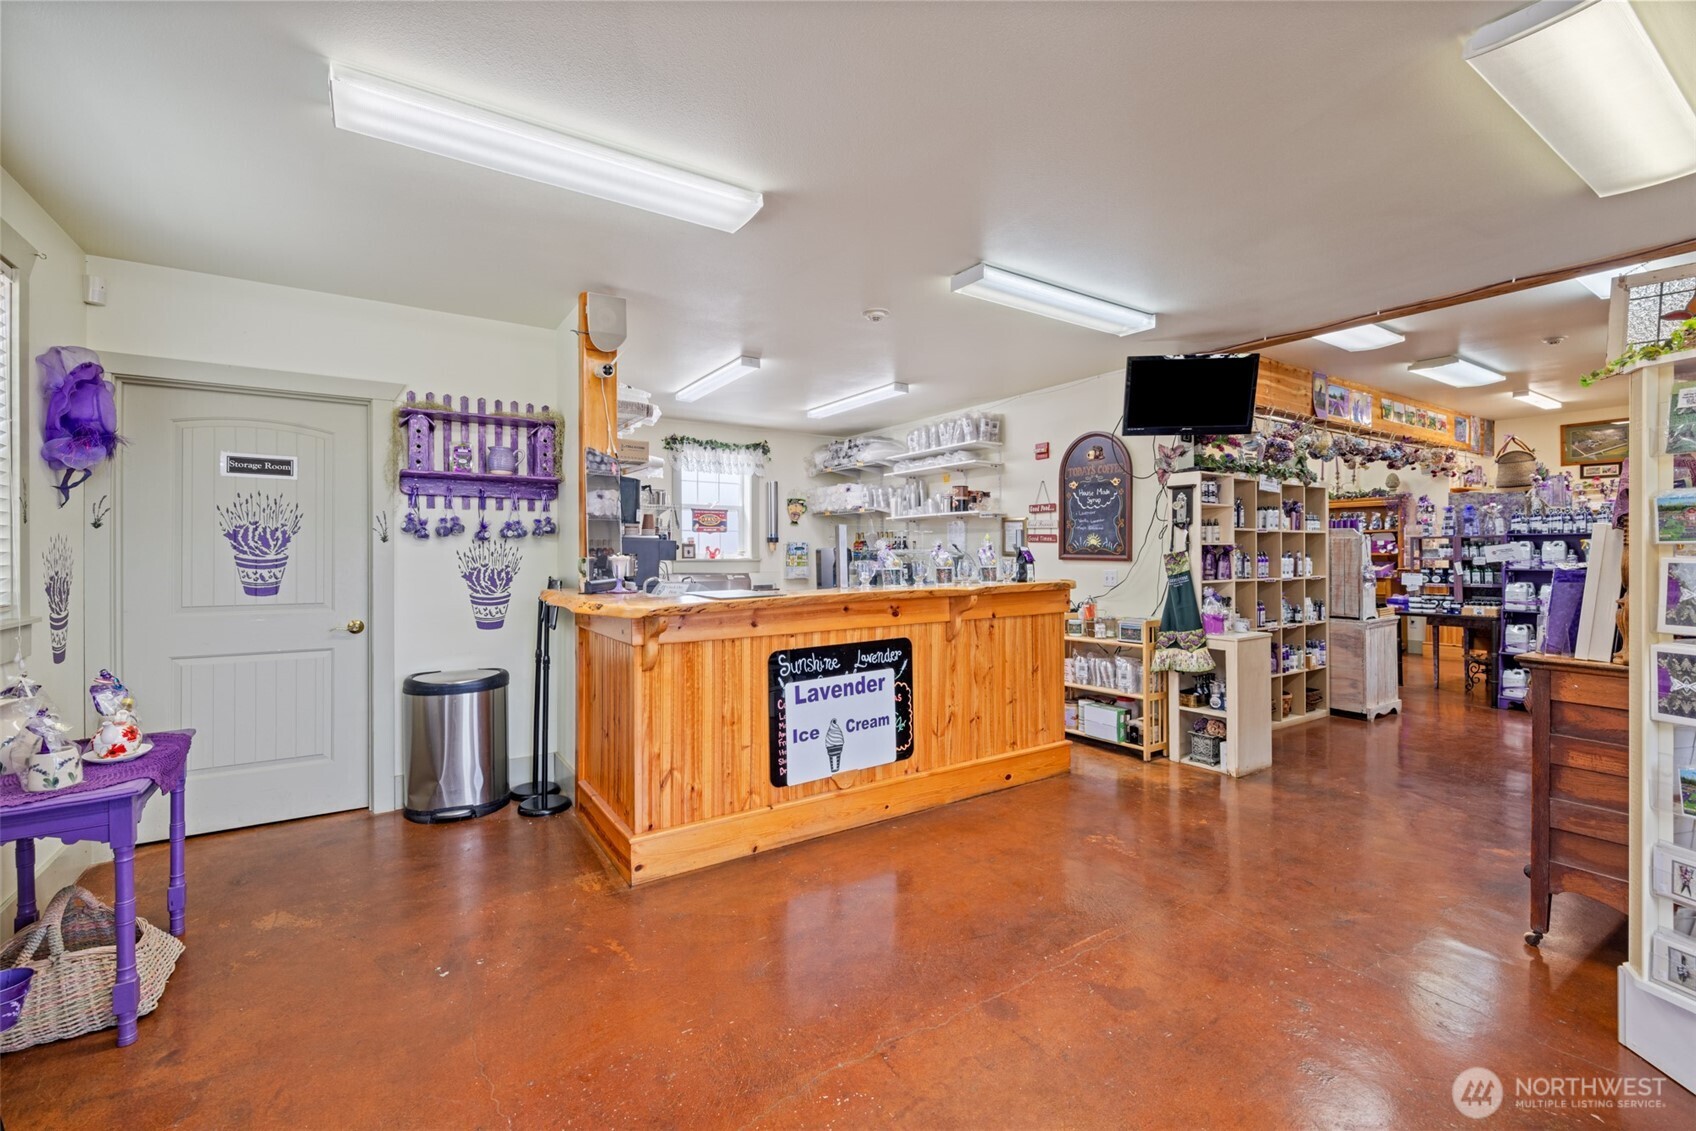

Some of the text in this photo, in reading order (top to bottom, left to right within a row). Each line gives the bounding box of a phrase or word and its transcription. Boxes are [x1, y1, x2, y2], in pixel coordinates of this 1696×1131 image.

[229, 460, 291, 471] Storage Room
[1078, 488, 1094, 497] House
[1086, 497, 1102, 505] Syrup
[778, 652, 841, 677] Sunshine
[854, 647, 903, 668] Lavender
[794, 675, 886, 705] Lavender
[792, 728, 820, 744] Ice
[845, 715, 890, 733] Cream
